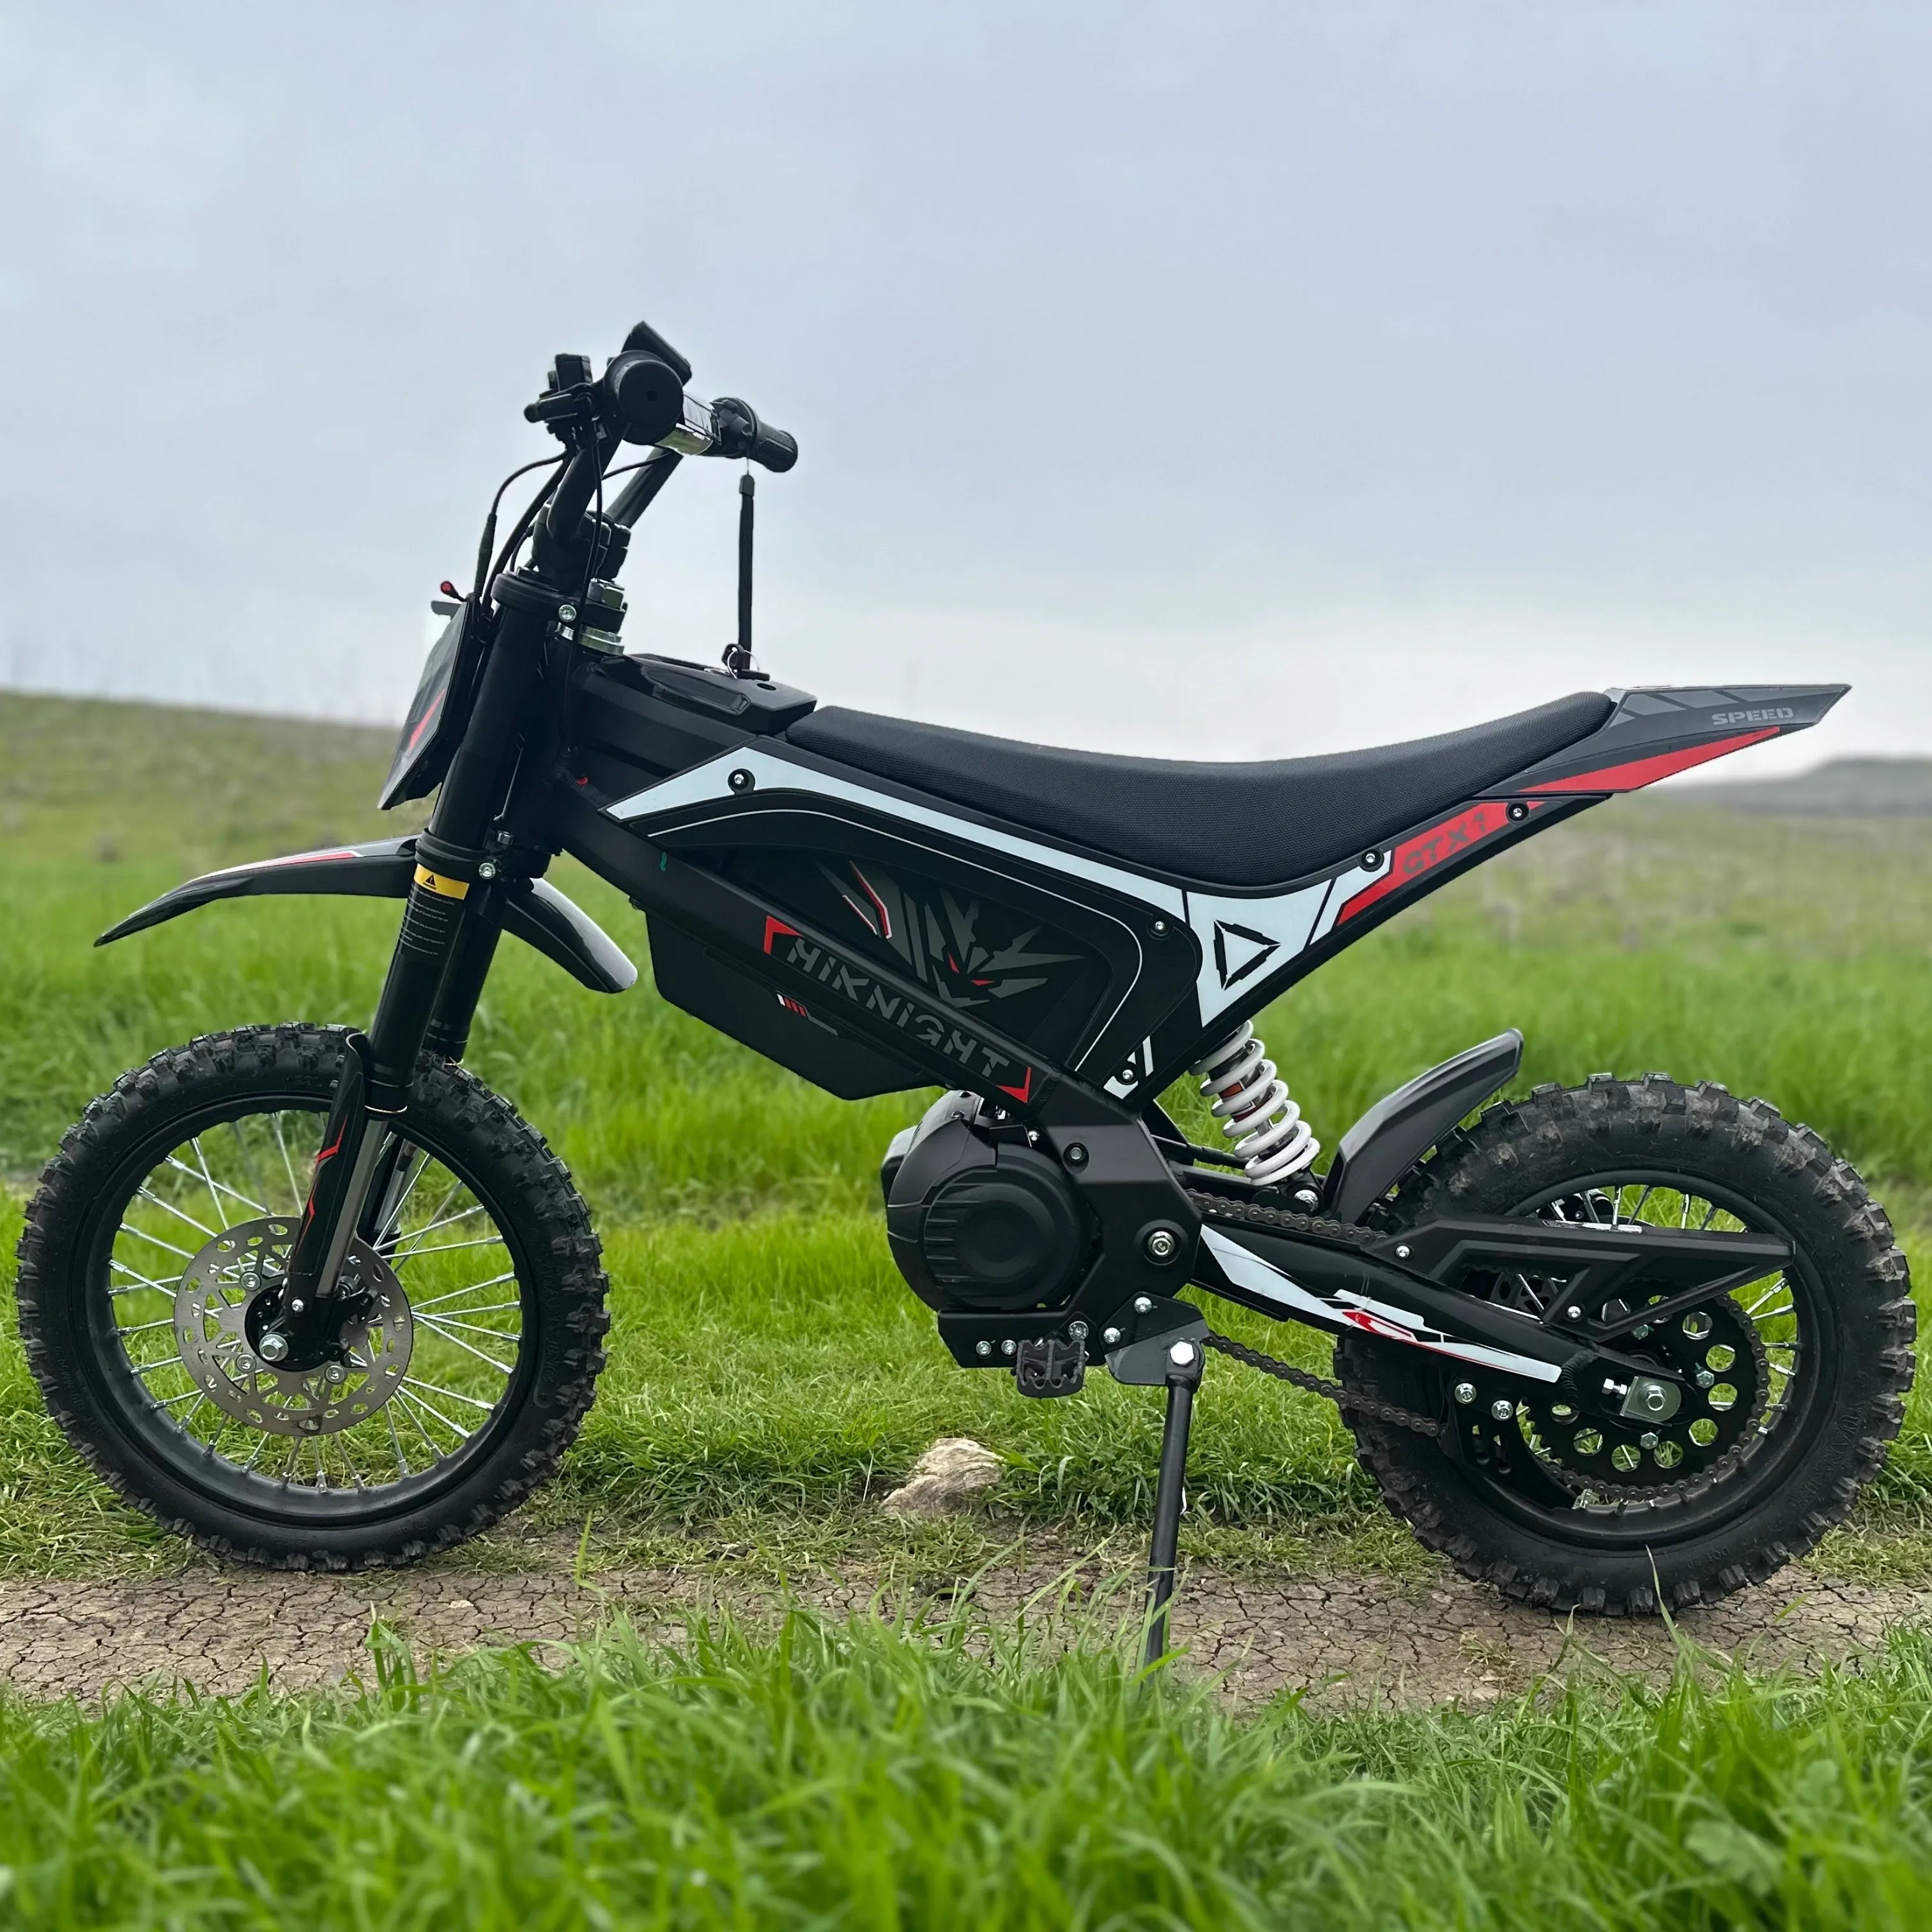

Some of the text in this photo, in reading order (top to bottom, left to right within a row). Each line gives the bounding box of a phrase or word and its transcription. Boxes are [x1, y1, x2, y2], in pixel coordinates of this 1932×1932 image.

[1712, 707, 1795, 726] SPEED
[1403, 811, 1485, 874] GTX1
[786, 937, 1010, 1078] HIKNIGHT
